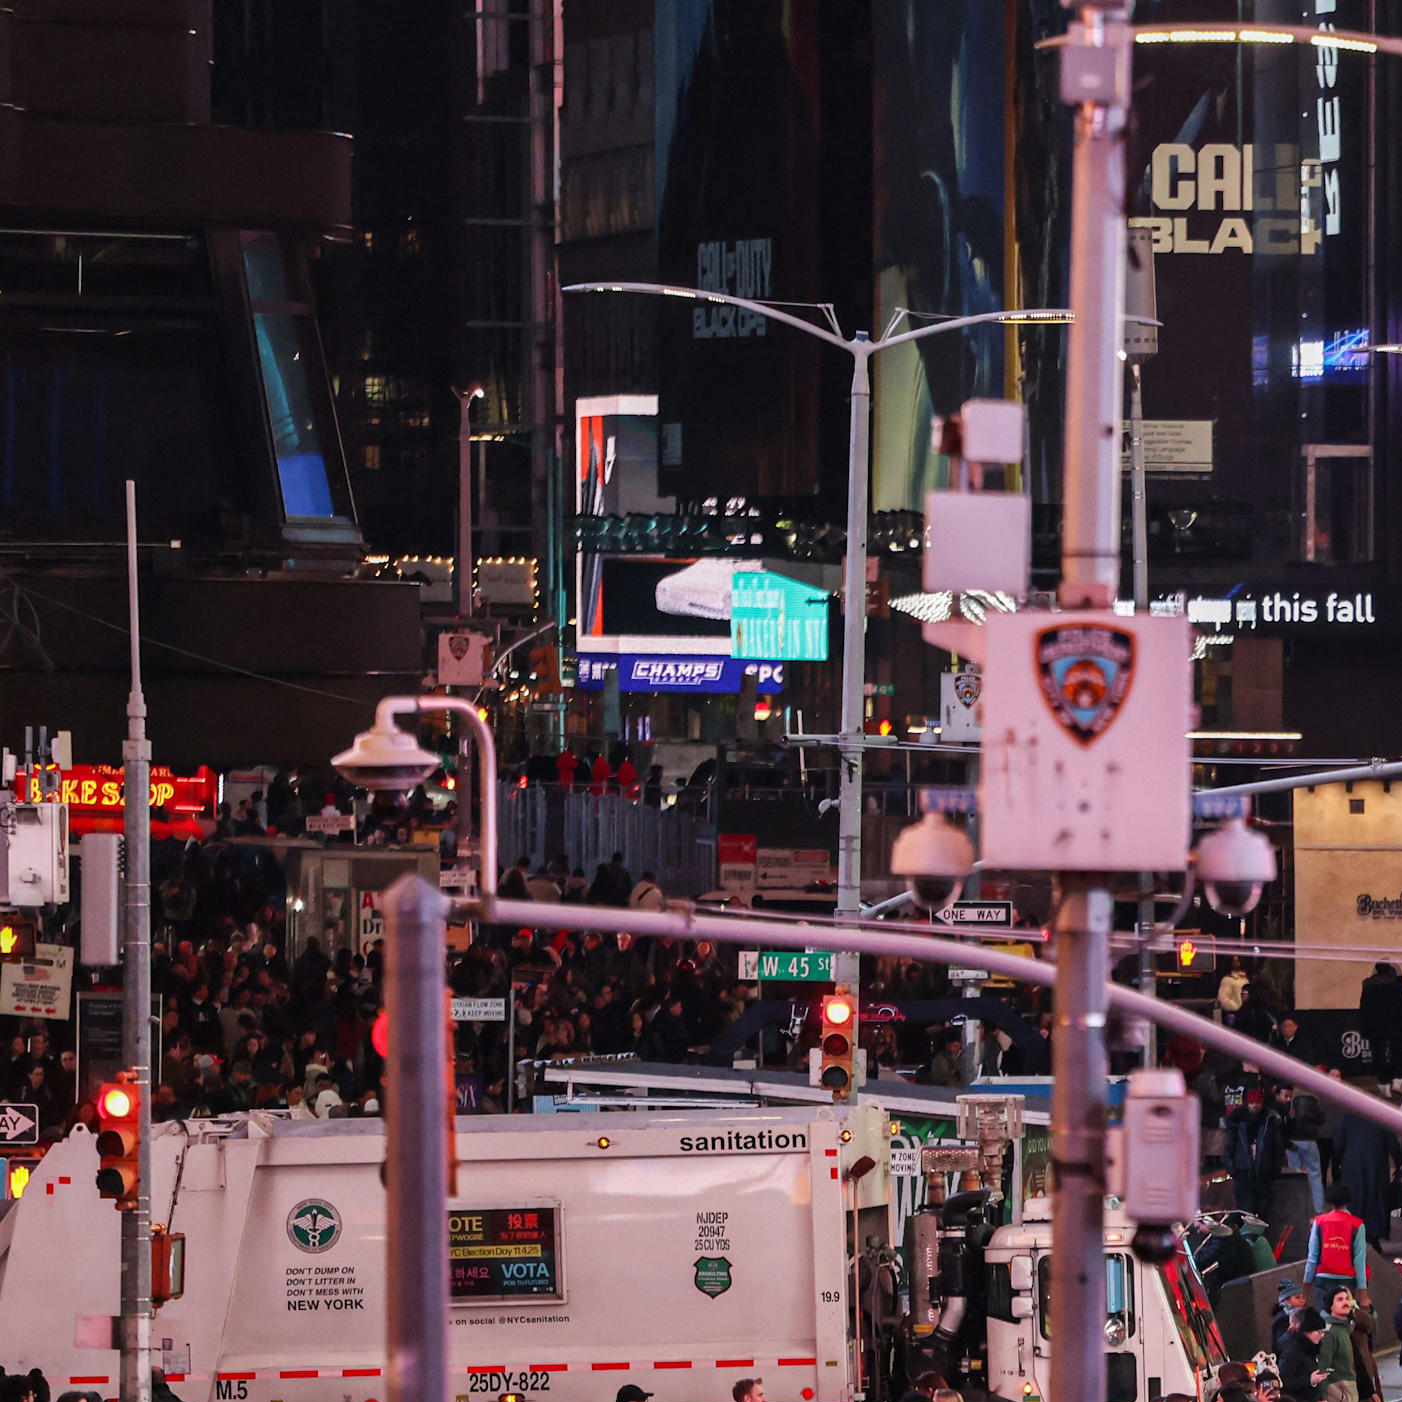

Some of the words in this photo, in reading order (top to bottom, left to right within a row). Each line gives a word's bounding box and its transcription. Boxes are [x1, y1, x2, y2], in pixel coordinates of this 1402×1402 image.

[1262, 592, 1317, 623] this
[1326, 592, 1375, 624] fall
[636, 662, 721, 677] CHAMPS
[30, 778, 98, 806] BKE
[943, 909, 965, 920] ONE
[977, 909, 1001, 920] WAY
[762, 956, 778, 975] W
[788, 958, 809, 977] 45
[819, 958, 830, 971] St
[680, 1129, 806, 1151] sanitation
[696, 1212, 728, 1224] NJDEP
[698, 1226, 725, 1237] 20947
[694, 1240, 703, 1250] 25
[704, 1240, 714, 1250] CU
[715, 1240, 730, 1250] YDS
[462, 1247, 495, 1257] Election
[496, 1246, 513, 1258] Day
[286, 1267, 314, 1275] DON'T
[315, 1266, 340, 1275] DUMP
[342, 1266, 355, 1274] ON
[501, 1262, 550, 1279] VOTA
[286, 1278, 314, 1286] DON'T
[314, 1277, 344, 1285] LITTER
[346, 1277, 355, 1285] IN
[315, 1288, 341, 1296] MESS
[343, 1287, 364, 1295] WITH
[821, 1292, 840, 1303] 19.9
[287, 1300, 319, 1311] NEW
[324, 1299, 364, 1310] YORK
[469, 1317, 496, 1326] social
[499, 1315, 570, 1325] @NYCsanitation
[469, 1372, 550, 1394] 25DY-822
[216, 1380, 248, 1401] M.5
